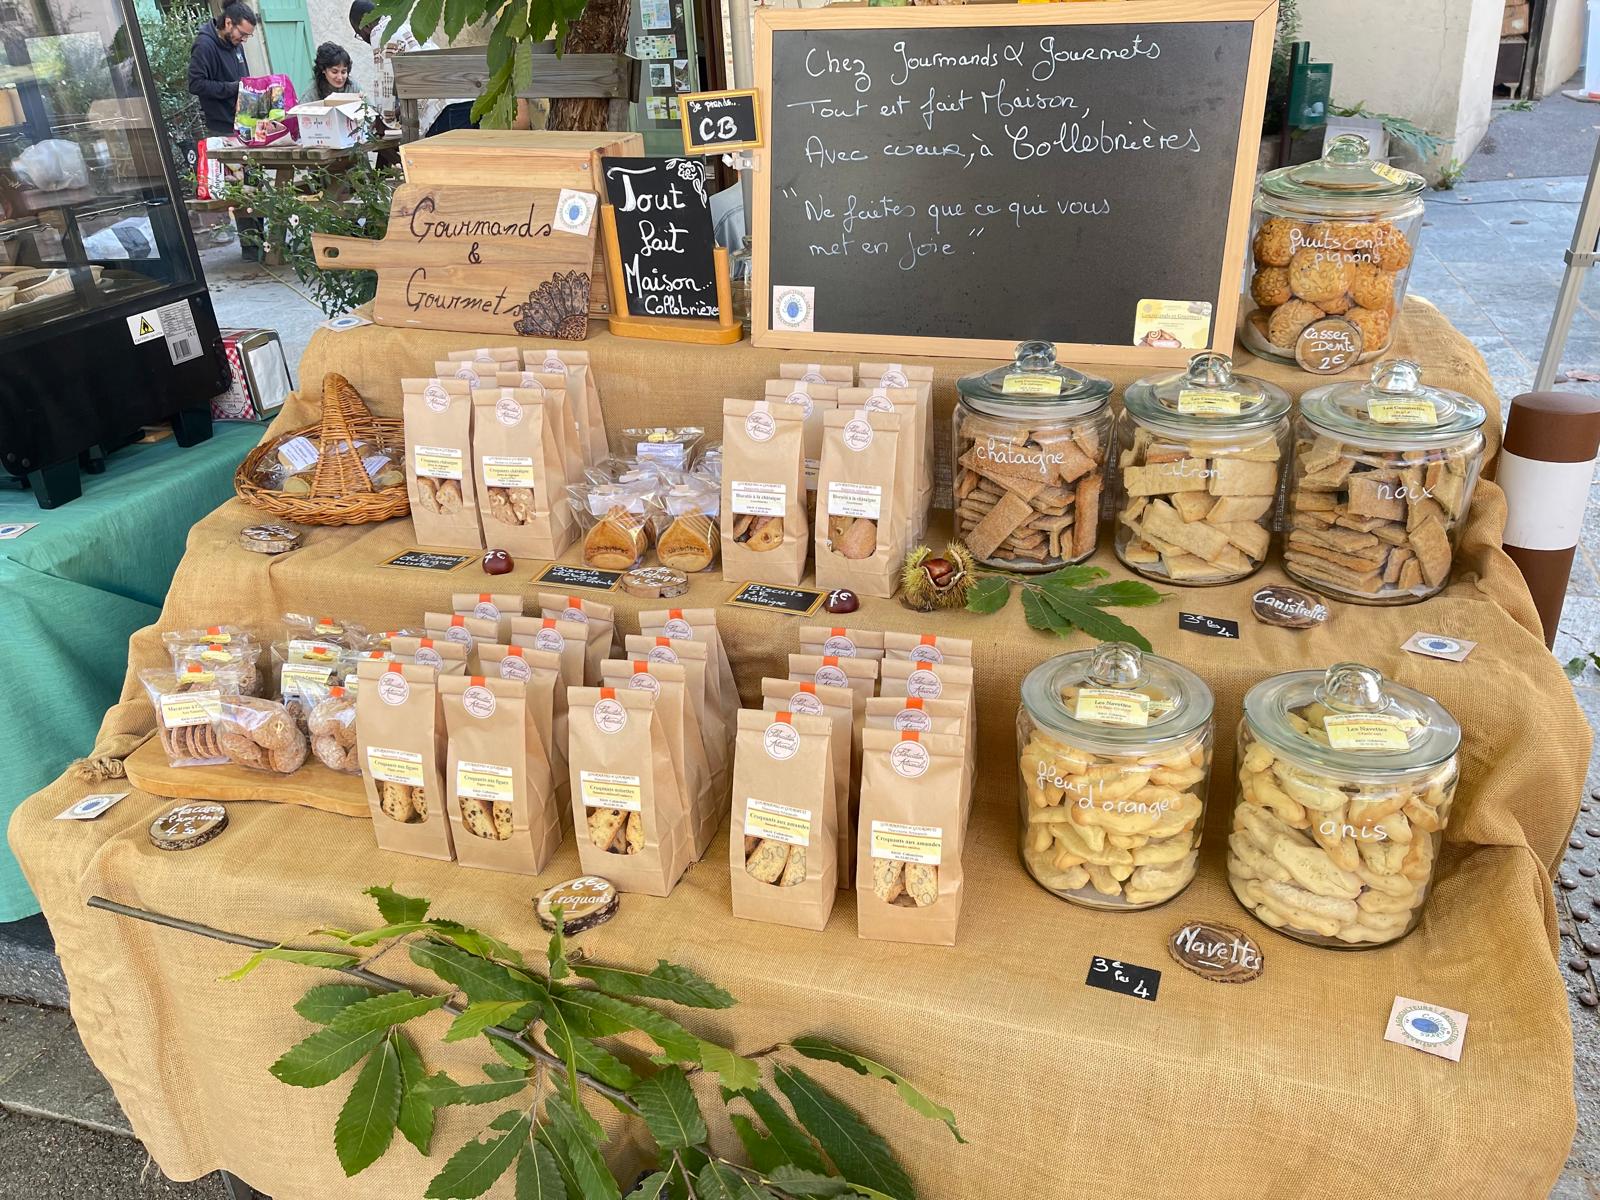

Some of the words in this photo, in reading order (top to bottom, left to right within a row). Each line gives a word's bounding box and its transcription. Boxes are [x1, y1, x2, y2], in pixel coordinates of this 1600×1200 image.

[805, 47, 870, 92] Chez
[786, 98, 869, 118] Tout
[920, 87, 973, 130] fait
[806, 135, 868, 163] Avec
[607, 166, 687, 213] Tout
[410, 196, 552, 244] Gourmands
[928, 202, 966, 235] que
[1008, 194, 1048, 228] qui
[1057, 198, 1111, 215] vous
[468, 242, 482, 264] &
[406, 267, 523, 317] Gourmets
[1376, 481, 1438, 502] noix
[1319, 819, 1388, 841] anis
[1176, 926, 1262, 970] Navettes
